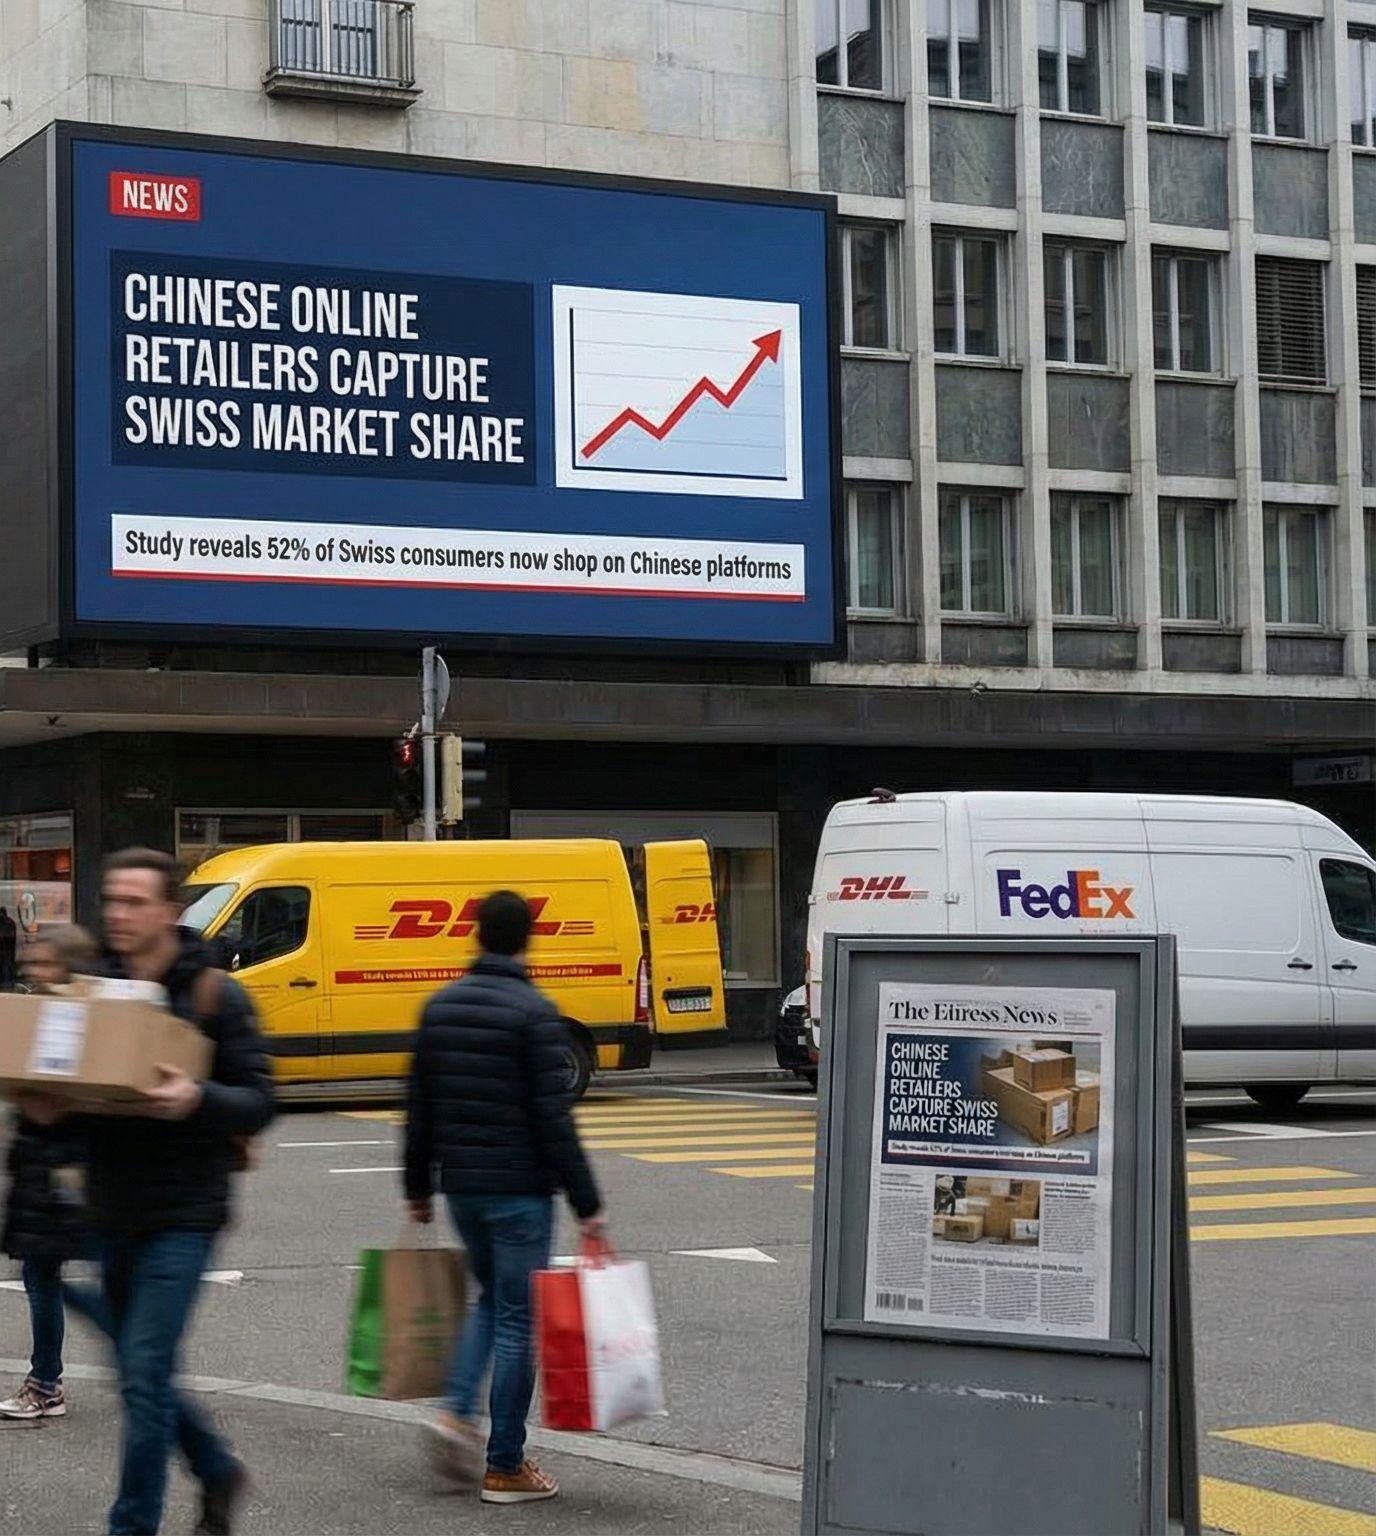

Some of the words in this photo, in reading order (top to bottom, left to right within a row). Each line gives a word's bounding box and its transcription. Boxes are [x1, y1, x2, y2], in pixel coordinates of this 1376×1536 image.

[123, 180, 188, 213] NEWS
[125, 273, 281, 331] CHINESE
[291, 286, 419, 340] ONLINE
[126, 335, 319, 393] RETAILERS
[330, 348, 490, 403] CAPTURE
[125, 395, 241, 448] SWISS
[253, 403, 400, 457] MARKET
[410, 412, 524, 463] SHARE
[125, 531, 184, 562] Study
[189, 535, 262, 559] reveals
[267, 537, 311, 561] 52%
[315, 538, 335, 562] of
[339, 540, 396, 565] Swiss
[400, 547, 505, 569] consumers
[510, 552, 549, 571] now
[553, 548, 598, 578] shop
[602, 556, 625, 574] on
[630, 551, 702, 576] Chinese
[706, 554, 792, 583] platforms
[838, 876, 912, 900] DHL
[996, 869, 1137, 919] FedEx
[889, 1001, 929, 1020] The
[1004, 1005, 1058, 1026] News
[891, 1042, 950, 1061] CHINESE
[891, 1060, 941, 1079] ONLINE
[890, 1079, 962, 1098] RETAILERS
[889, 1097, 953, 1116] CAPTURE
[954, 1099, 999, 1118] SWISS
[888, 1115, 947, 1134] MARKET
[948, 1117, 996, 1137] SHARE
